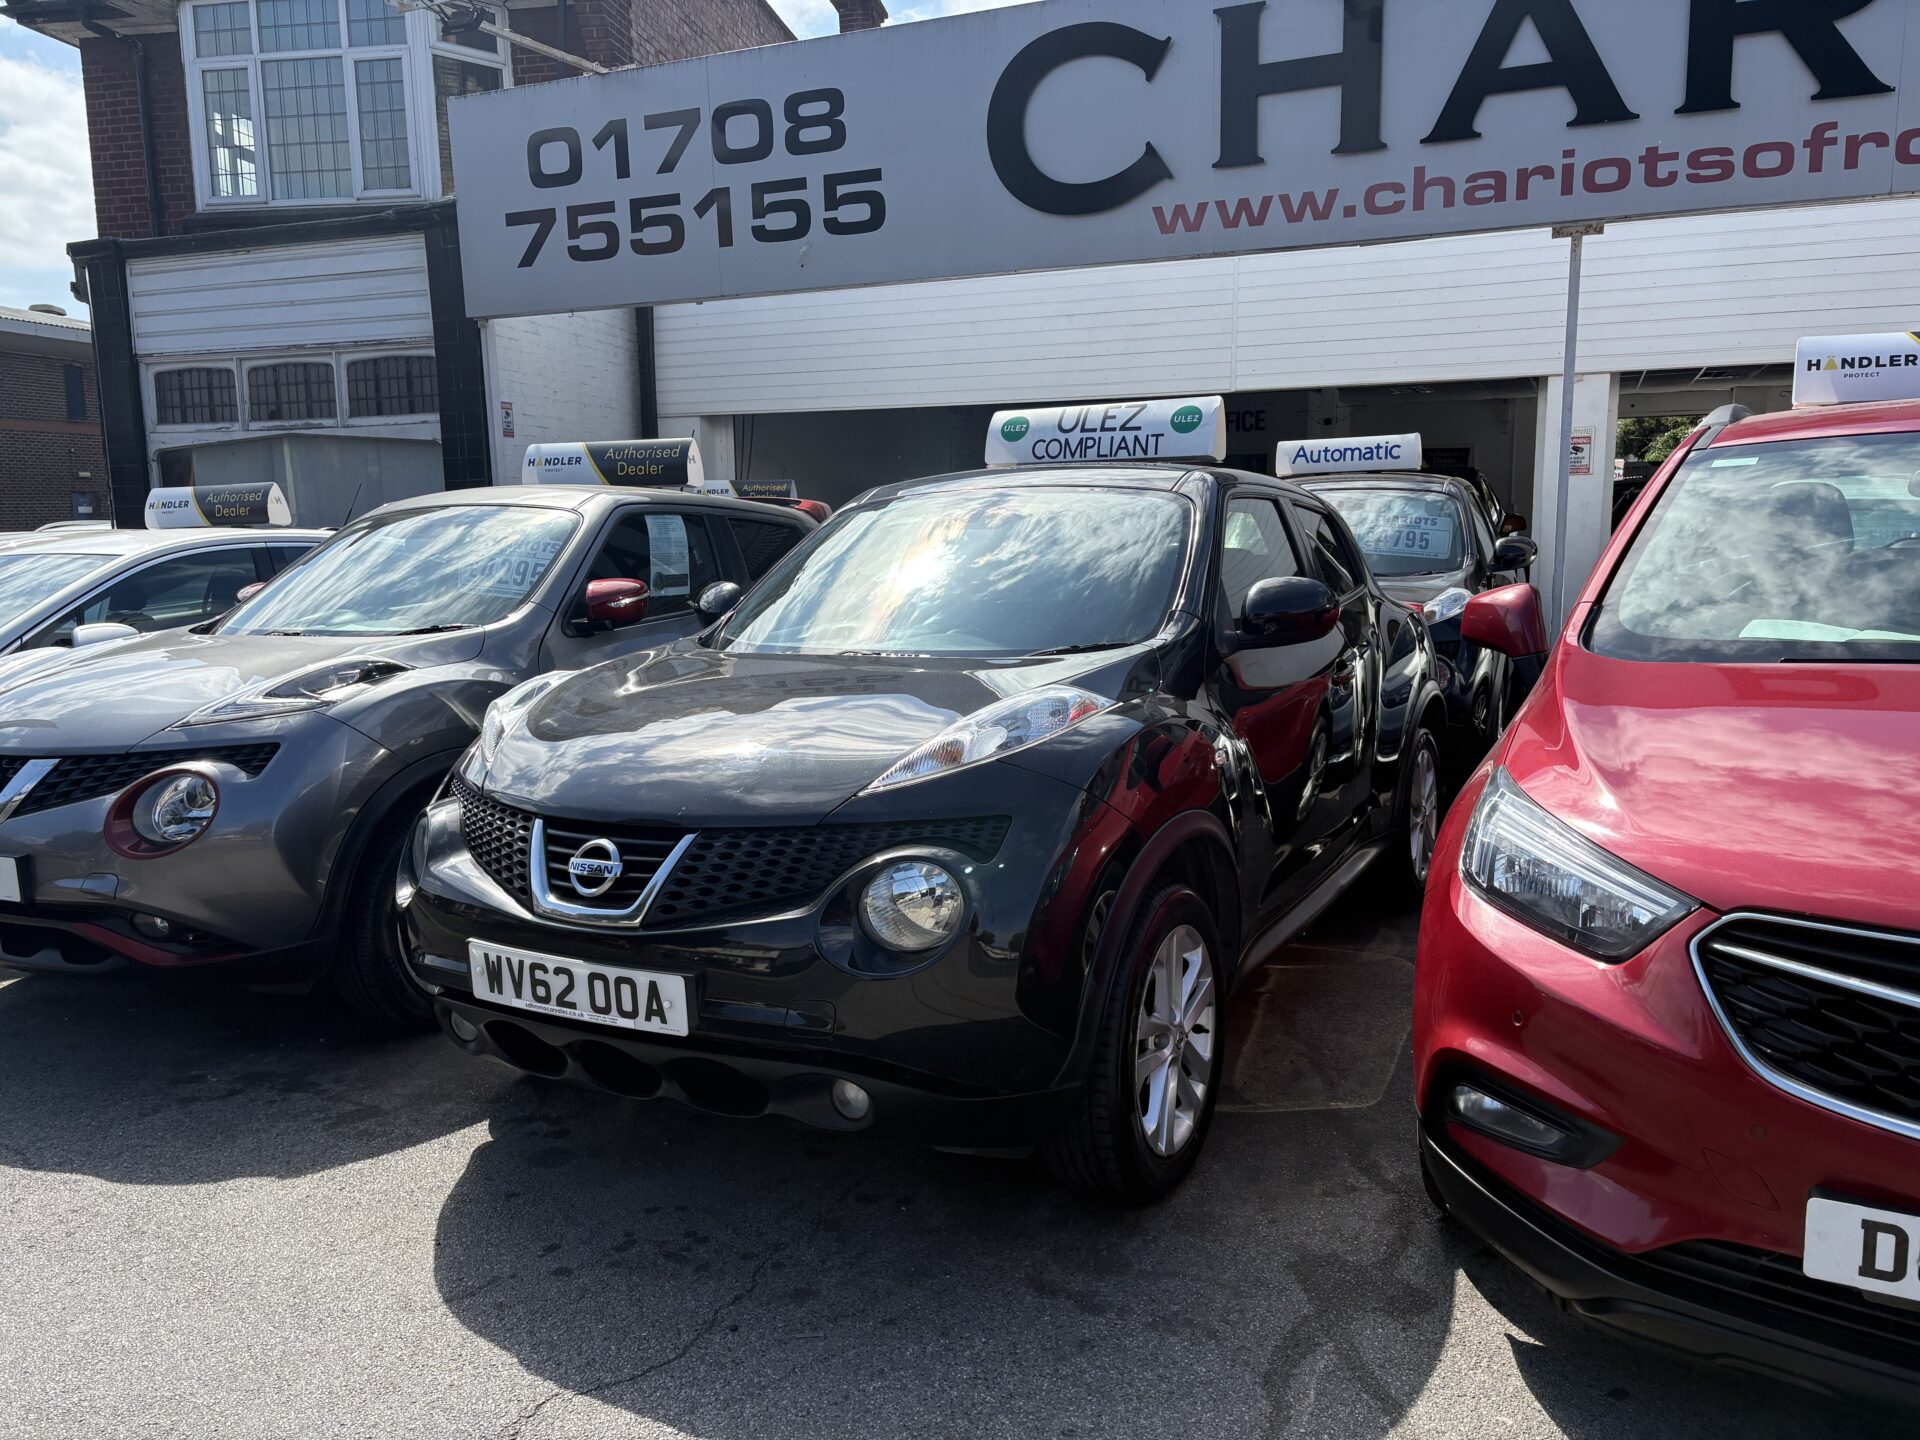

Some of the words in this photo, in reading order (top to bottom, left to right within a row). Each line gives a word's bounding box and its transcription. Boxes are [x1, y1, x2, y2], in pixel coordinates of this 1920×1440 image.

[986, 0, 1895, 217] CHAR
[526, 86, 847, 189] 01708
[504, 167, 887, 269] 755155
[1807, 354, 1919, 371] HANDLER
[1057, 403, 1148, 434] ULEZ
[1174, 413, 1200, 423] ULEZ
[1226, 410, 1266, 432] FICE
[1004, 423, 1028, 433] ULEZ
[604, 445, 681, 460] Authorised
[1031, 433, 1165, 460] COMPLIANT
[1292, 441, 1402, 465] Automatic
[528, 456, 582, 467] HANDLER
[617, 461, 664, 476] Dealer
[742, 483, 787, 491] Authorised
[206, 489, 263, 503] Authorised
[148, 500, 189, 510] HANDLER
[215, 504, 250, 517] Dealer
[570, 861, 614, 875] NISSAN
[483, 952, 577, 1010] WV62
[587, 972, 668, 1025] OOA
[1858, 1219, 1920, 1283] D
